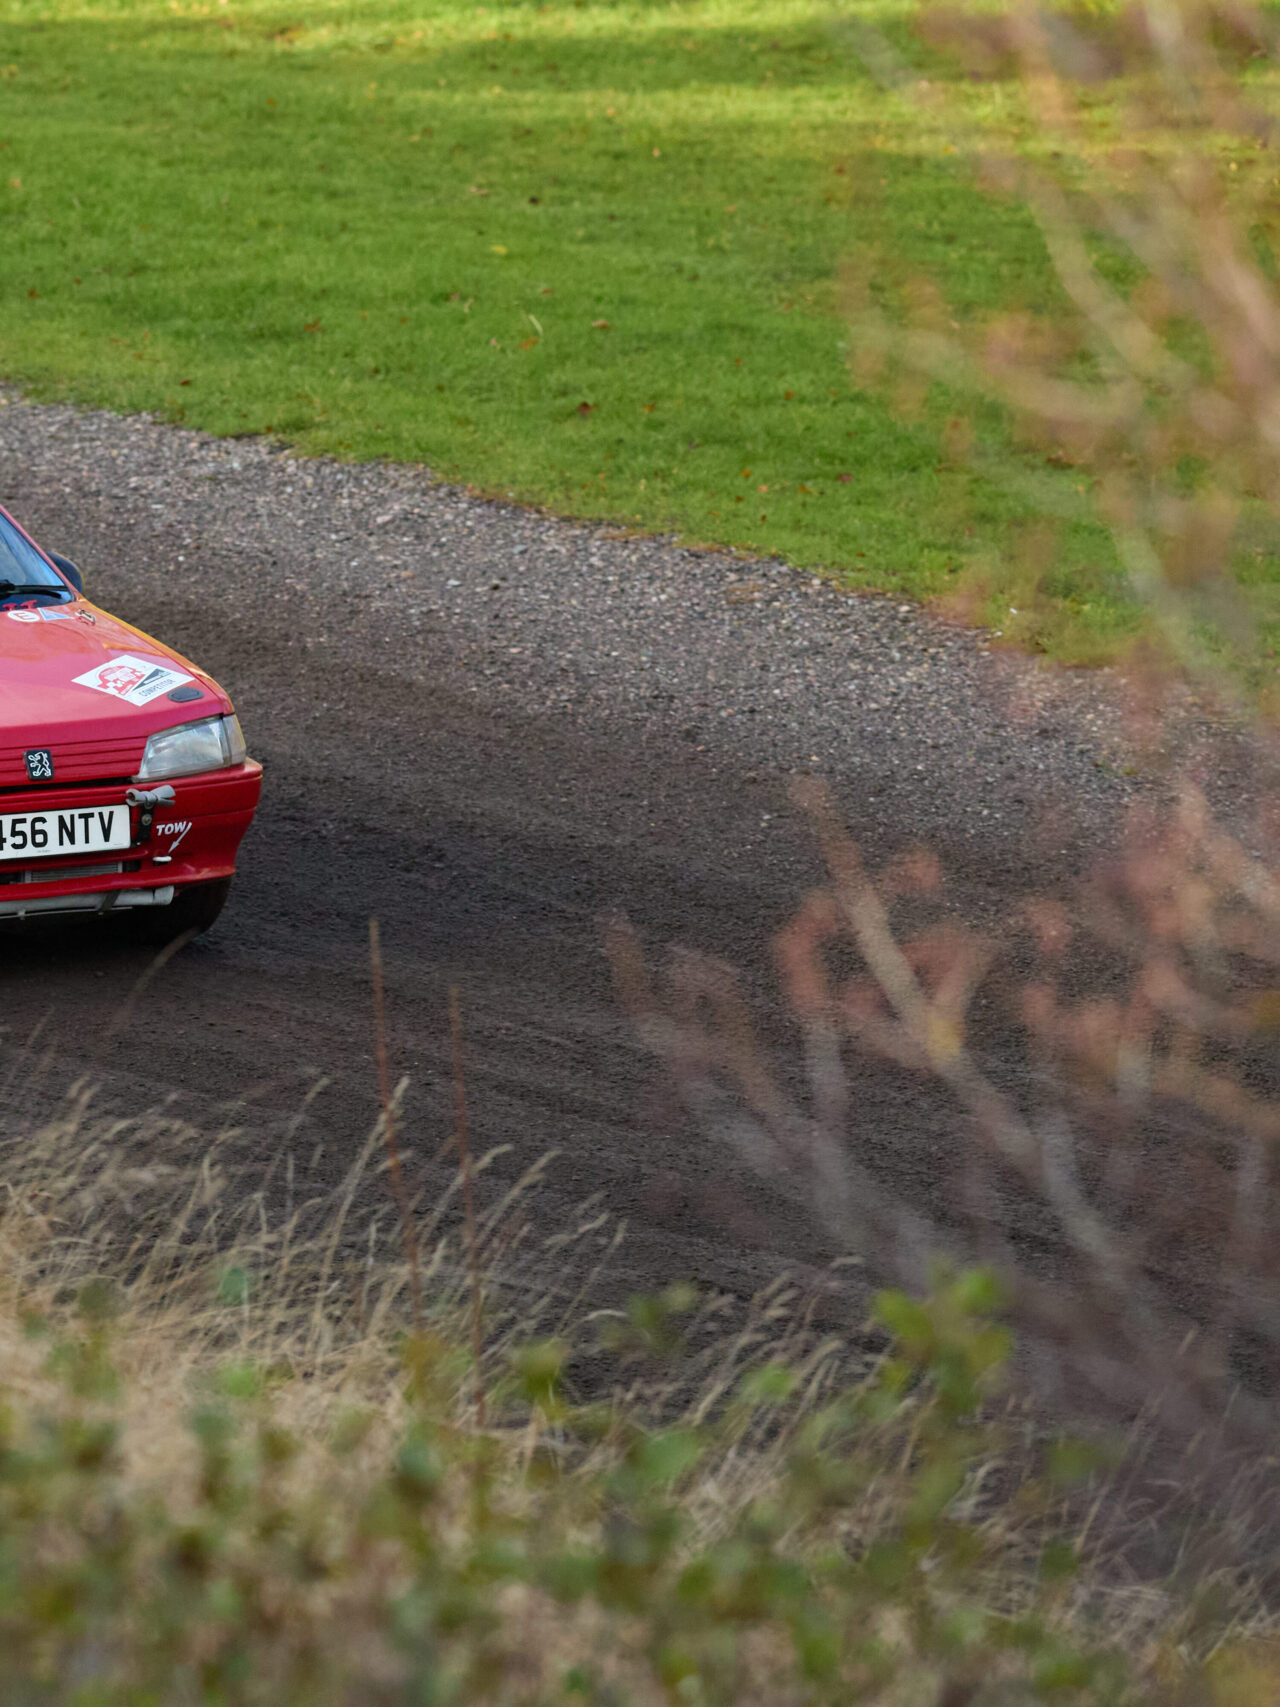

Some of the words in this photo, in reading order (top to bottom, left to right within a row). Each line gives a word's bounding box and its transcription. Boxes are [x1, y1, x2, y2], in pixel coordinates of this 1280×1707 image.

[138, 679, 176, 697] COMPETITOR
[58, 810, 114, 847] NTV
[156, 821, 187, 836] TOW
